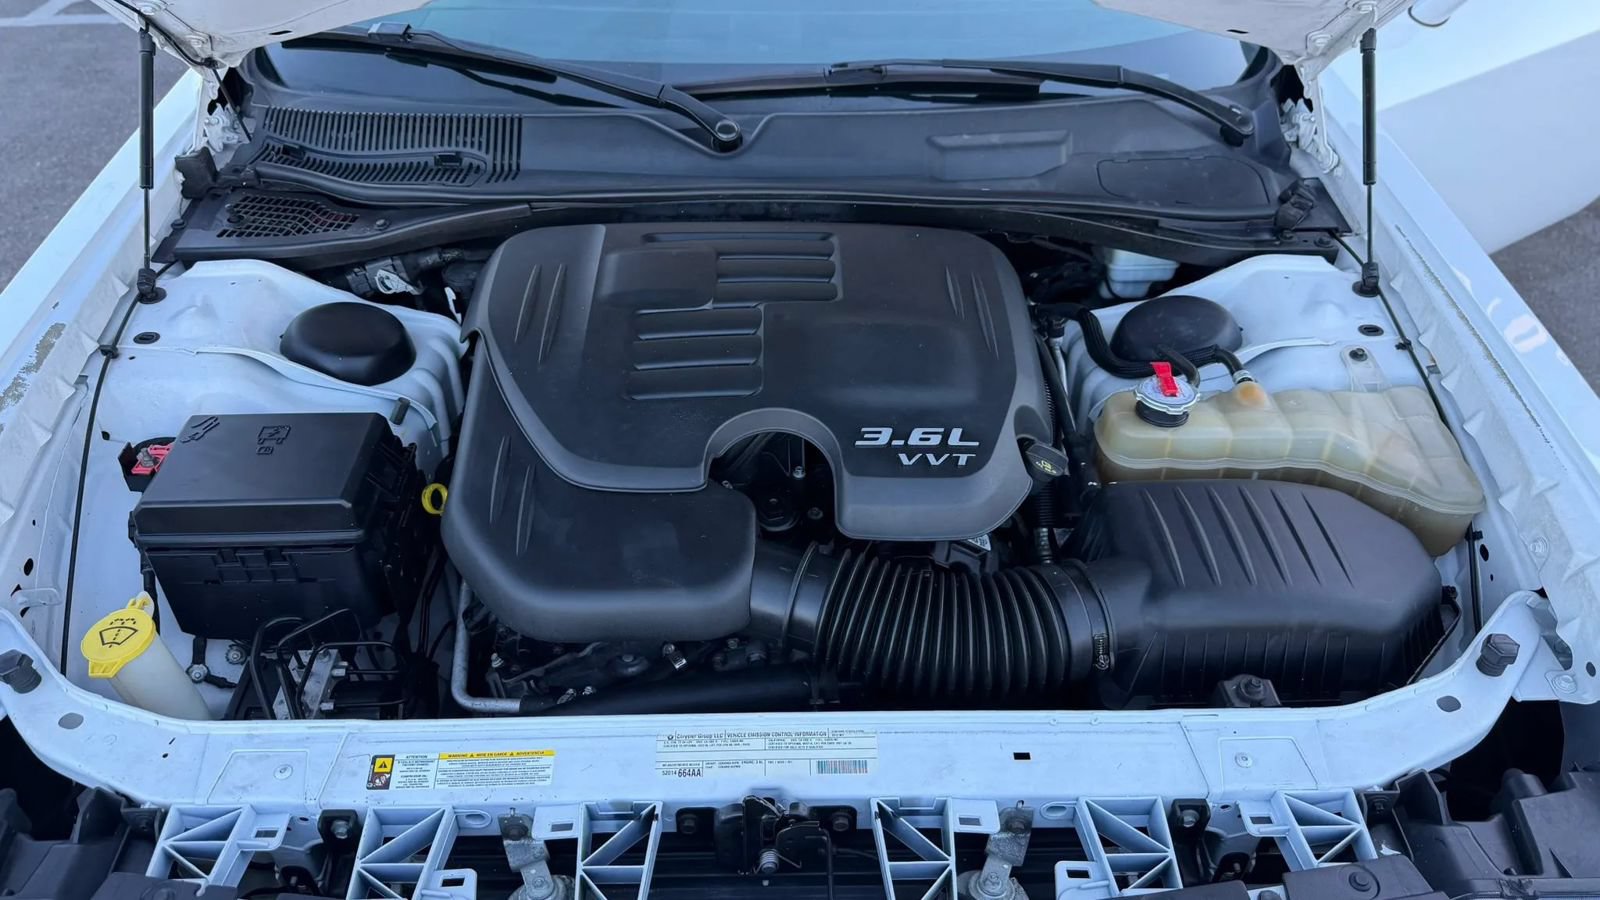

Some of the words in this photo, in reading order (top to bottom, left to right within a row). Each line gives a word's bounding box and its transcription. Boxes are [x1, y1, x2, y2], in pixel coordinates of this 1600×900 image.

[855, 427, 980, 446] 3.6L
[897, 453, 976, 466] VVT
[677, 768, 701, 777] 664AA
